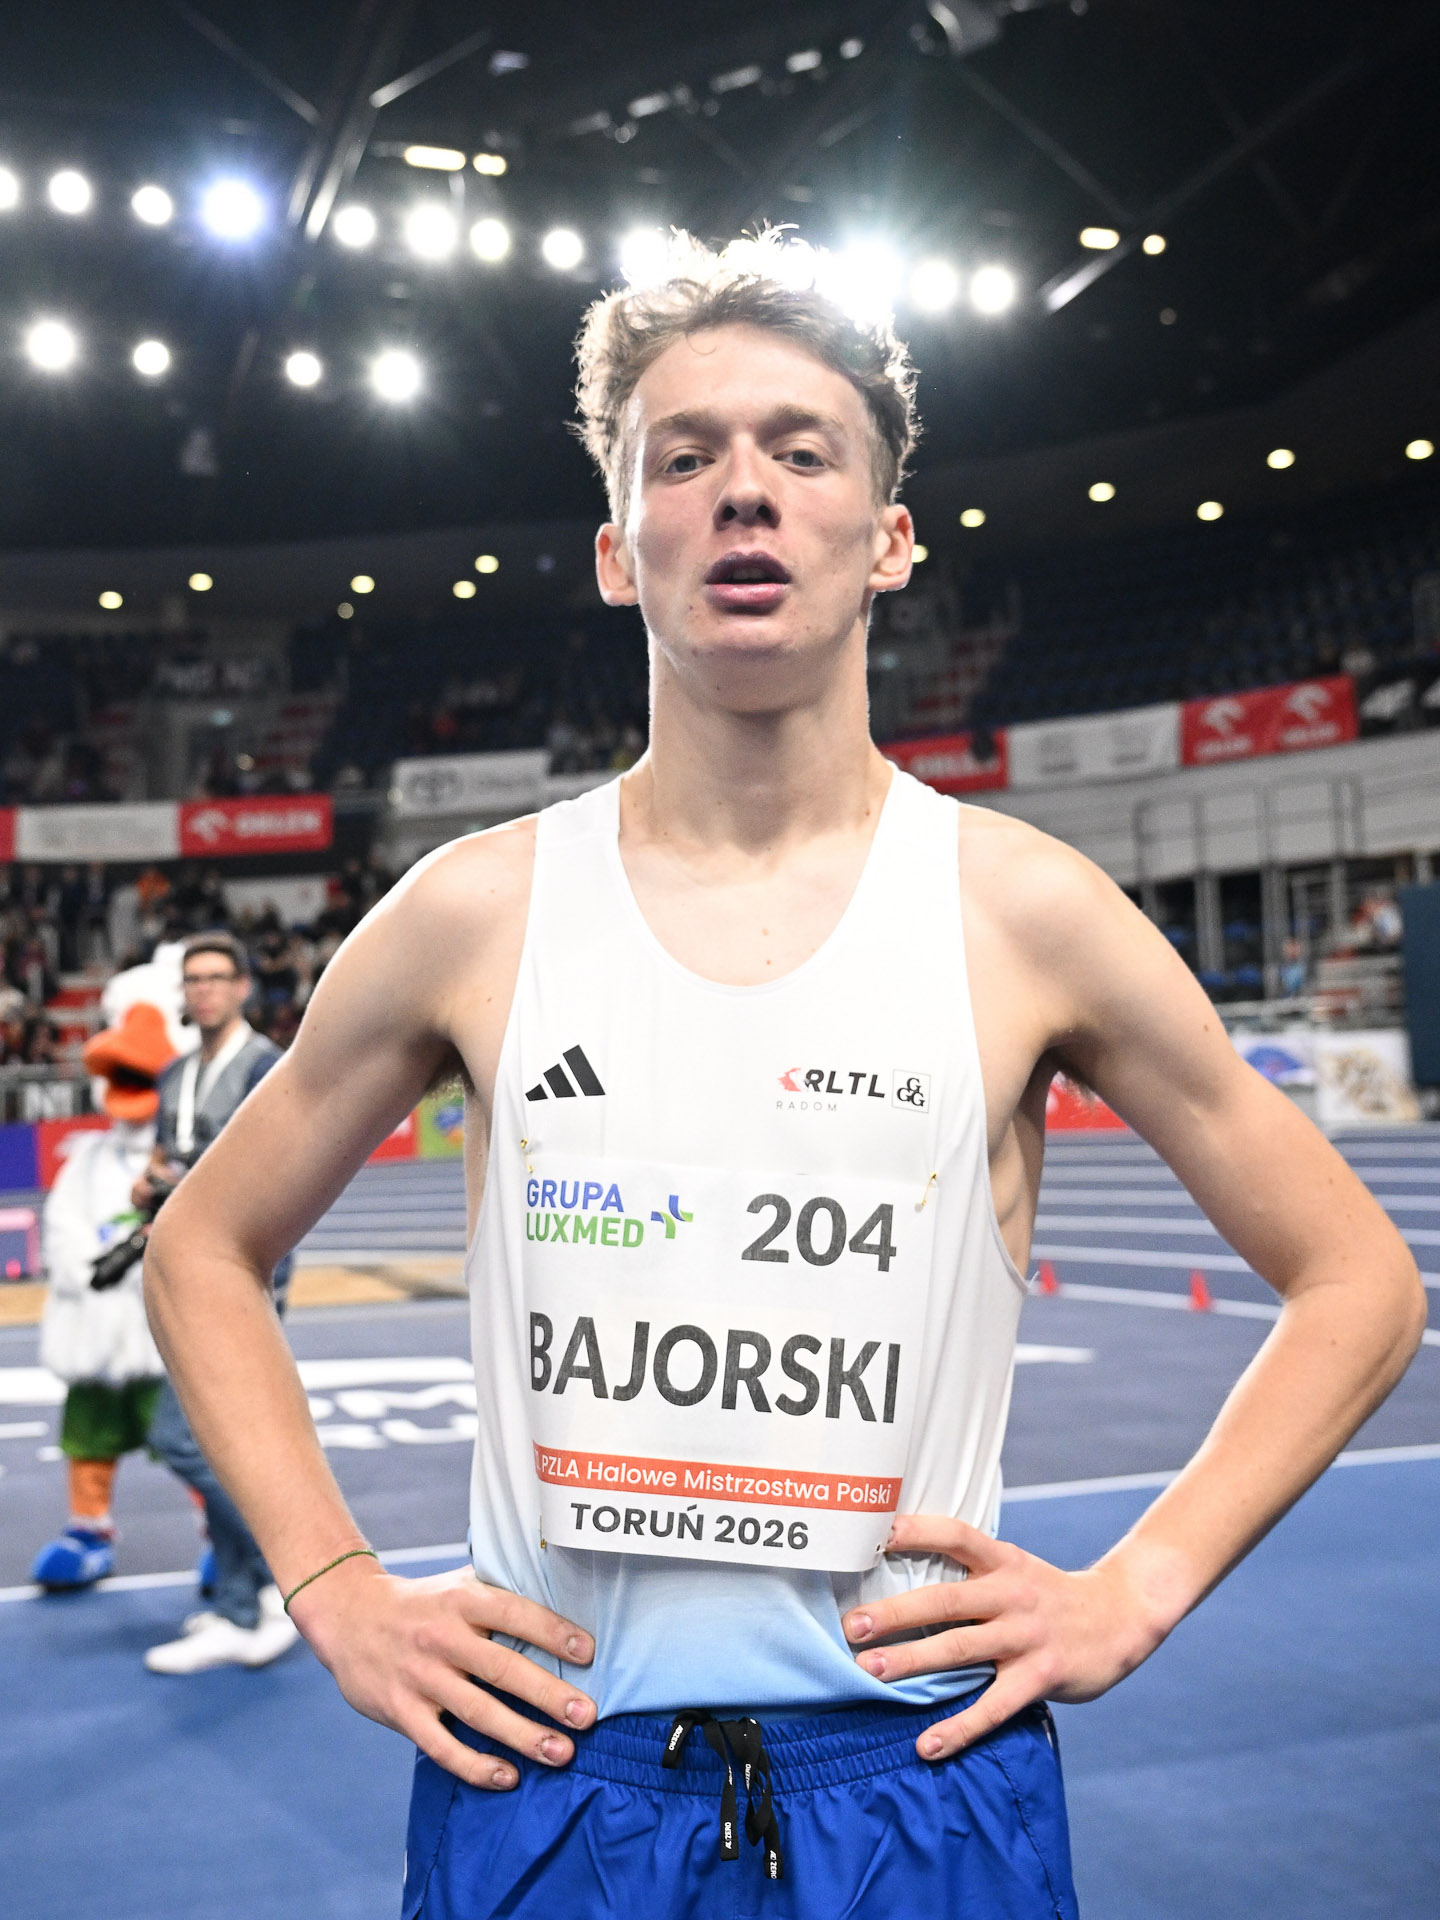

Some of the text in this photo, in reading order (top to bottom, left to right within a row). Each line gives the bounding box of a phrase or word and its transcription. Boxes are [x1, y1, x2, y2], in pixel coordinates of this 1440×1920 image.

[804, 1069, 885, 1099] RLTL
[776, 1100, 837, 1112] RADOM
[527, 1179, 624, 1213] GRUPA
[527, 1212, 644, 1248] LUXMED
[741, 1193, 897, 1273] 204
[530, 1311, 901, 1424] BAJORSKI
[541, 1454, 580, 1479] PZLA
[586, 1460, 677, 1487] Halowe
[684, 1469, 830, 1502] Mistrzostwa
[836, 1482, 891, 1504] Polski
[570, 1502, 809, 1550] TORUŃ 2026
